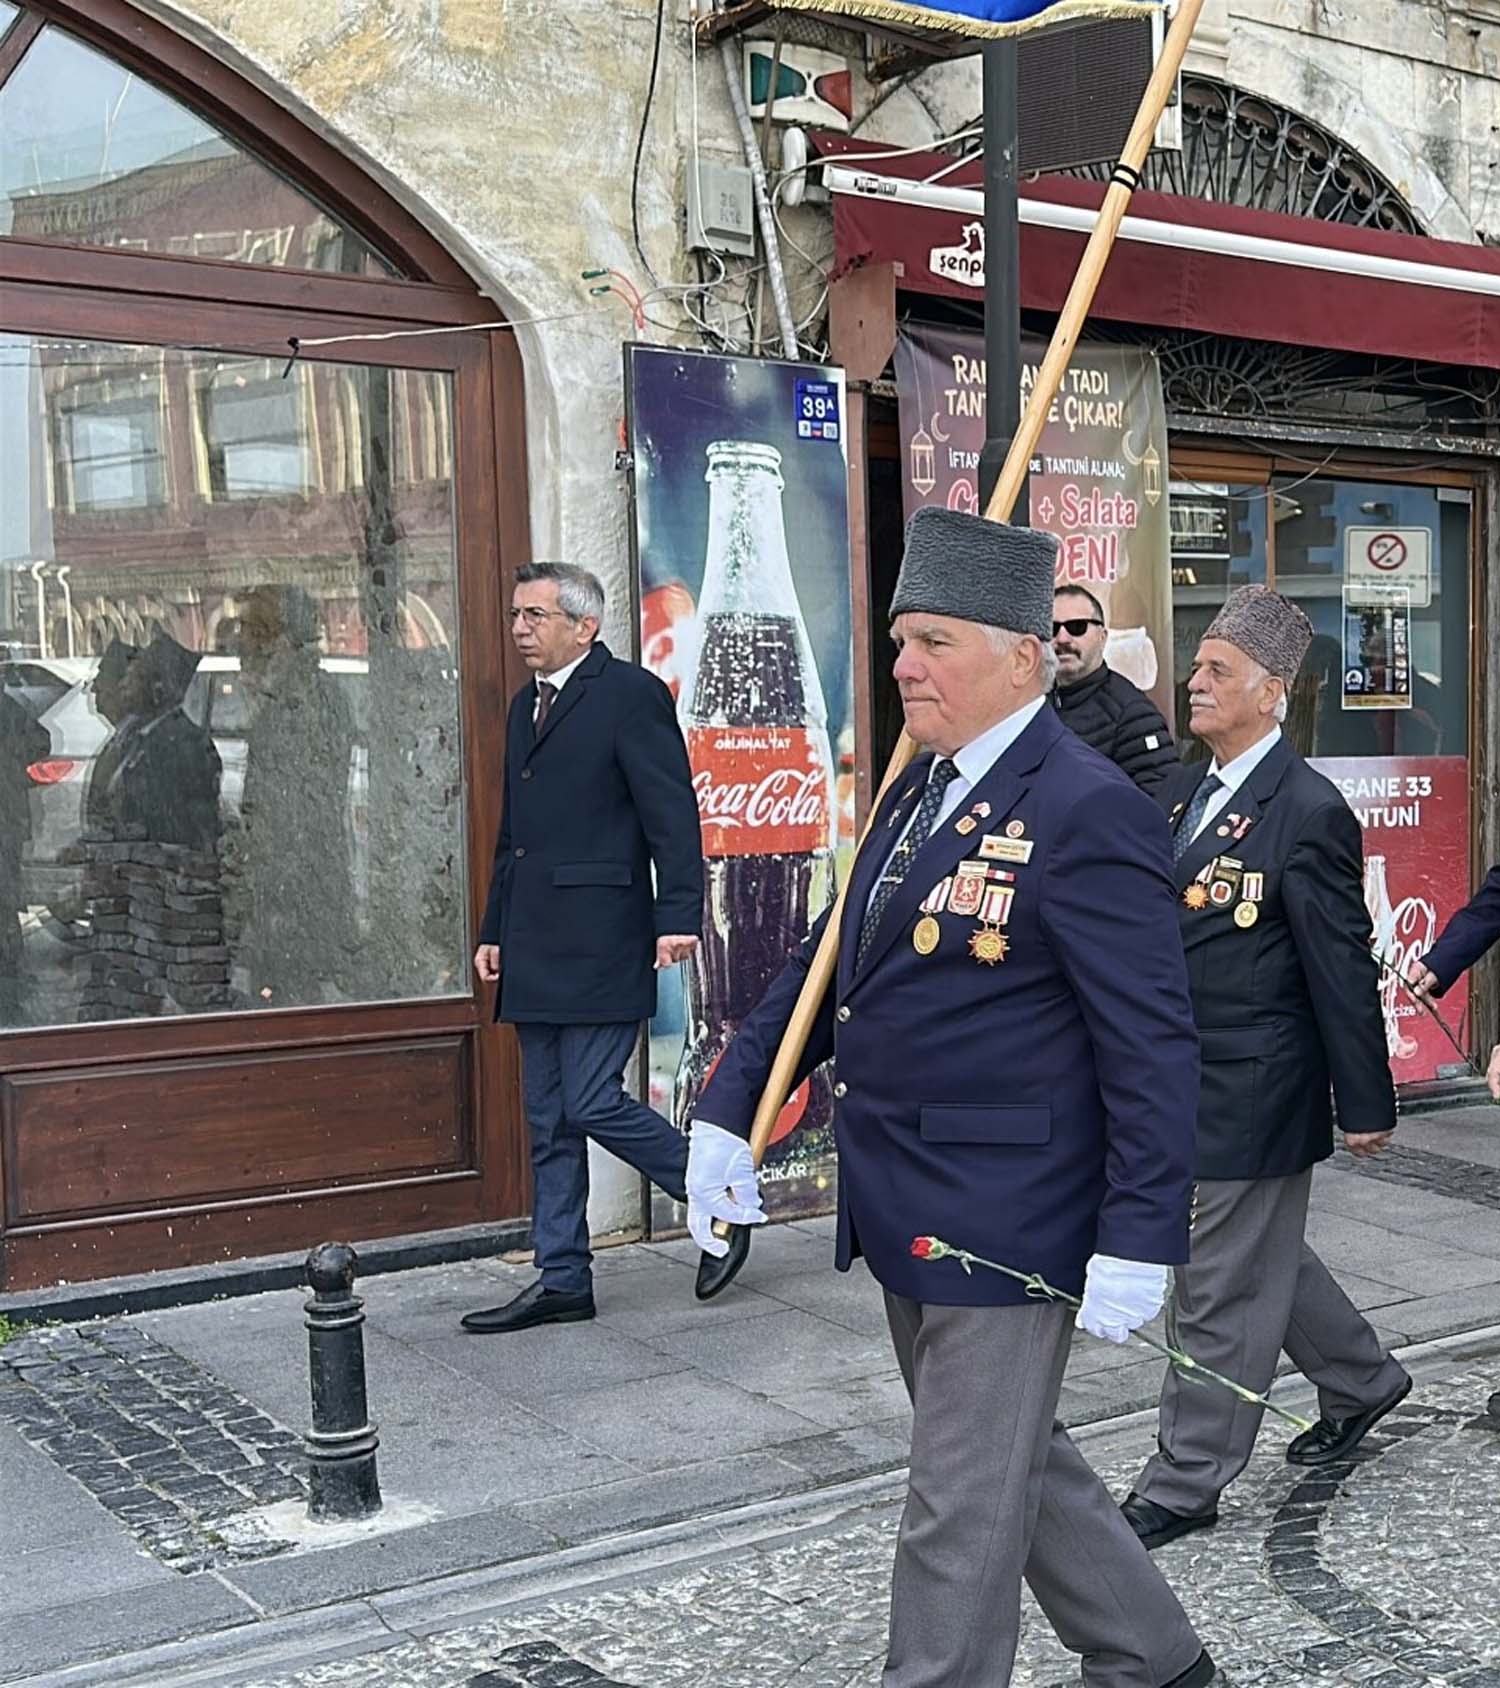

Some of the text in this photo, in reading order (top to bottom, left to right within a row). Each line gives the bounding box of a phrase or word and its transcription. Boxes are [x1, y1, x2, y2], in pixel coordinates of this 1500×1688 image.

[940, 254, 982, 278] şenp
[1069, 368, 1109, 395] TADI
[1064, 396, 1123, 432] ÇIKAR!
[1047, 456, 1089, 475] TANTUNİ
[1060, 484, 1136, 530] Salata
[692, 768, 826, 827] Coca-Cola
[1405, 775, 1432, 797] 33
[1353, 800, 1420, 828] NTUNİ
